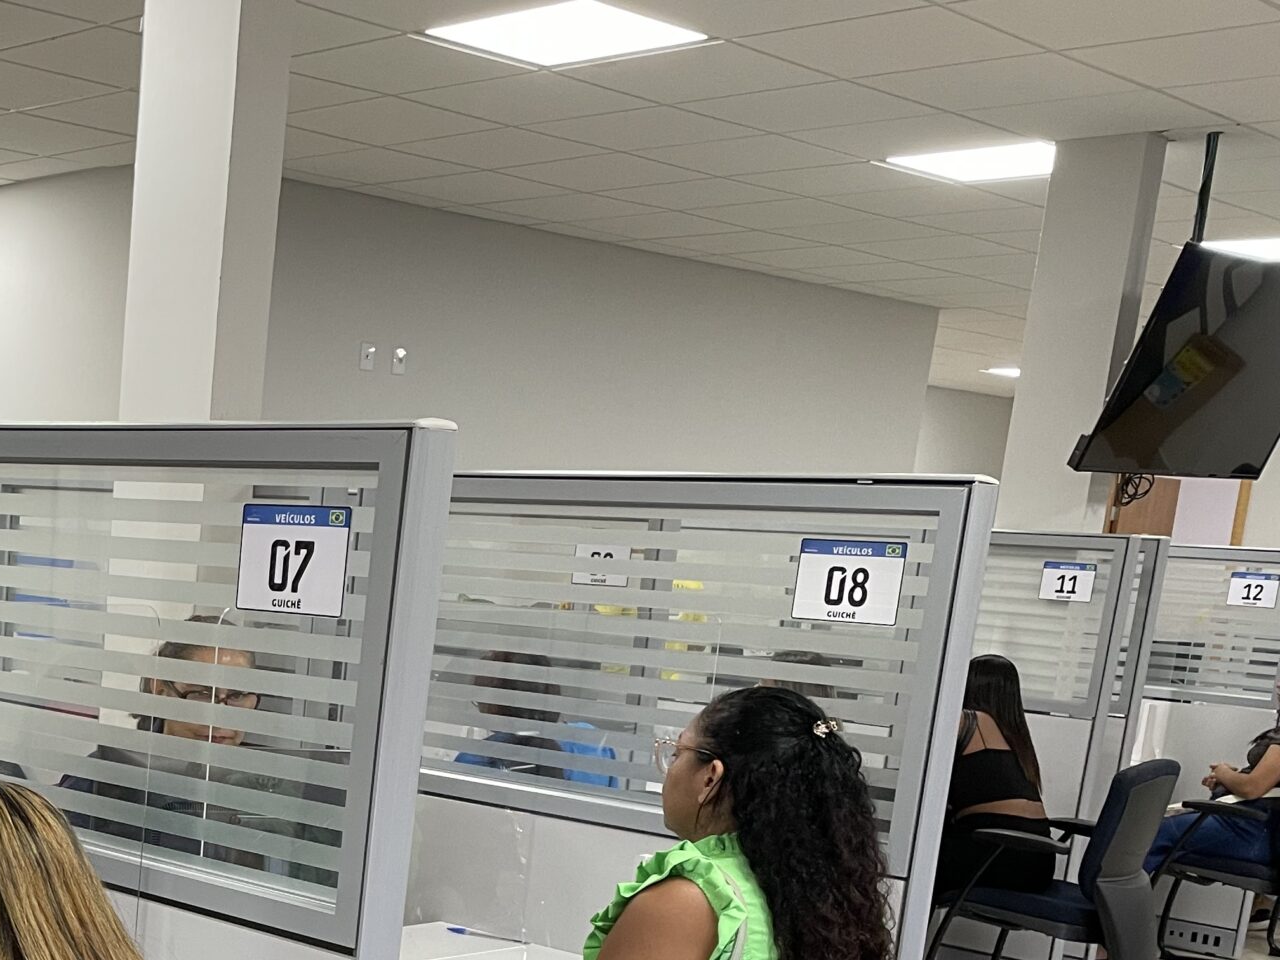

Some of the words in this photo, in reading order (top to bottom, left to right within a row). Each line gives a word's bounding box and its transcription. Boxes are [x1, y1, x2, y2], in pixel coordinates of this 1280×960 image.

[275, 512, 316, 524] VEÍCULOS
[832, 545, 873, 556] VEÍCULOS
[268, 539, 315, 593] 07
[824, 566, 870, 607] 08
[1054, 574, 1078, 594] 11
[1241, 583, 1264, 601] 12
[271, 598, 301, 609] GUICHÊ
[826, 610, 856, 619] GUICHÊ
